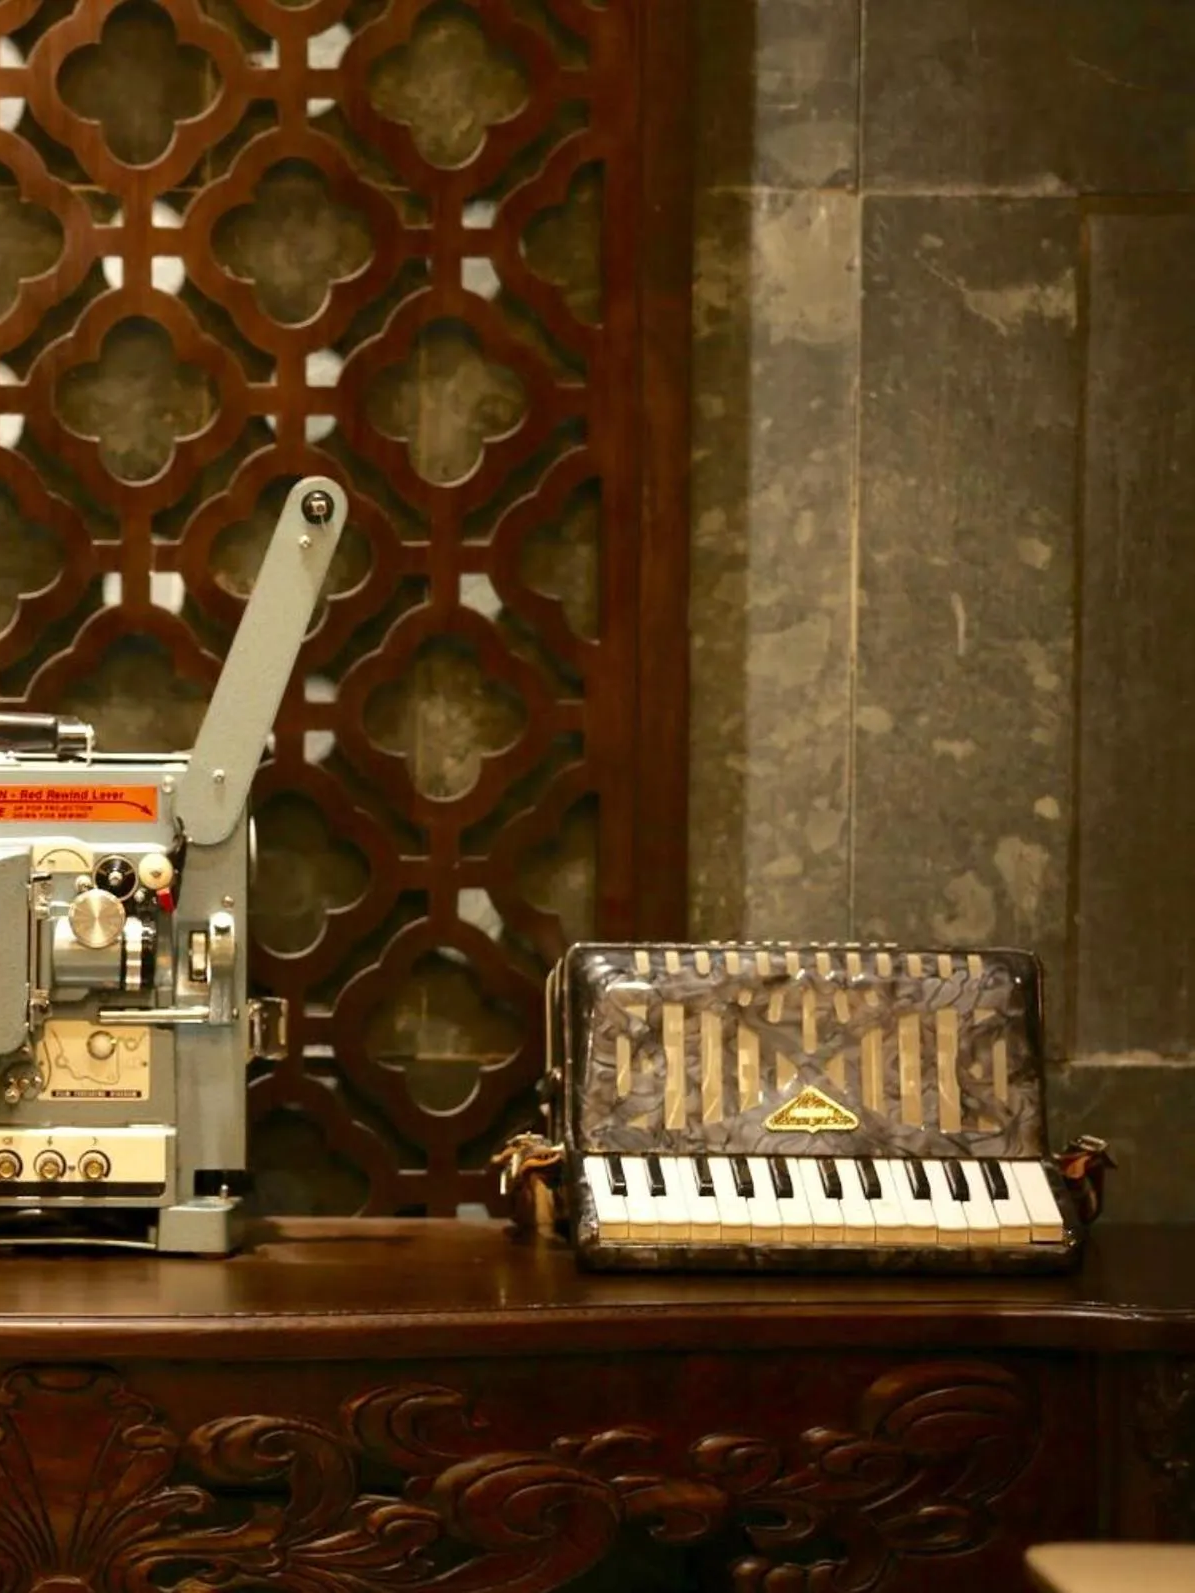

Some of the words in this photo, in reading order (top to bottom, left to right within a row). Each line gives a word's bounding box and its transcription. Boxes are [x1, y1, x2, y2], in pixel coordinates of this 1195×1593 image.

[20, 789, 43, 800] Red
[46, 789, 89, 800] Rewind
[92, 789, 124, 800] Lever
